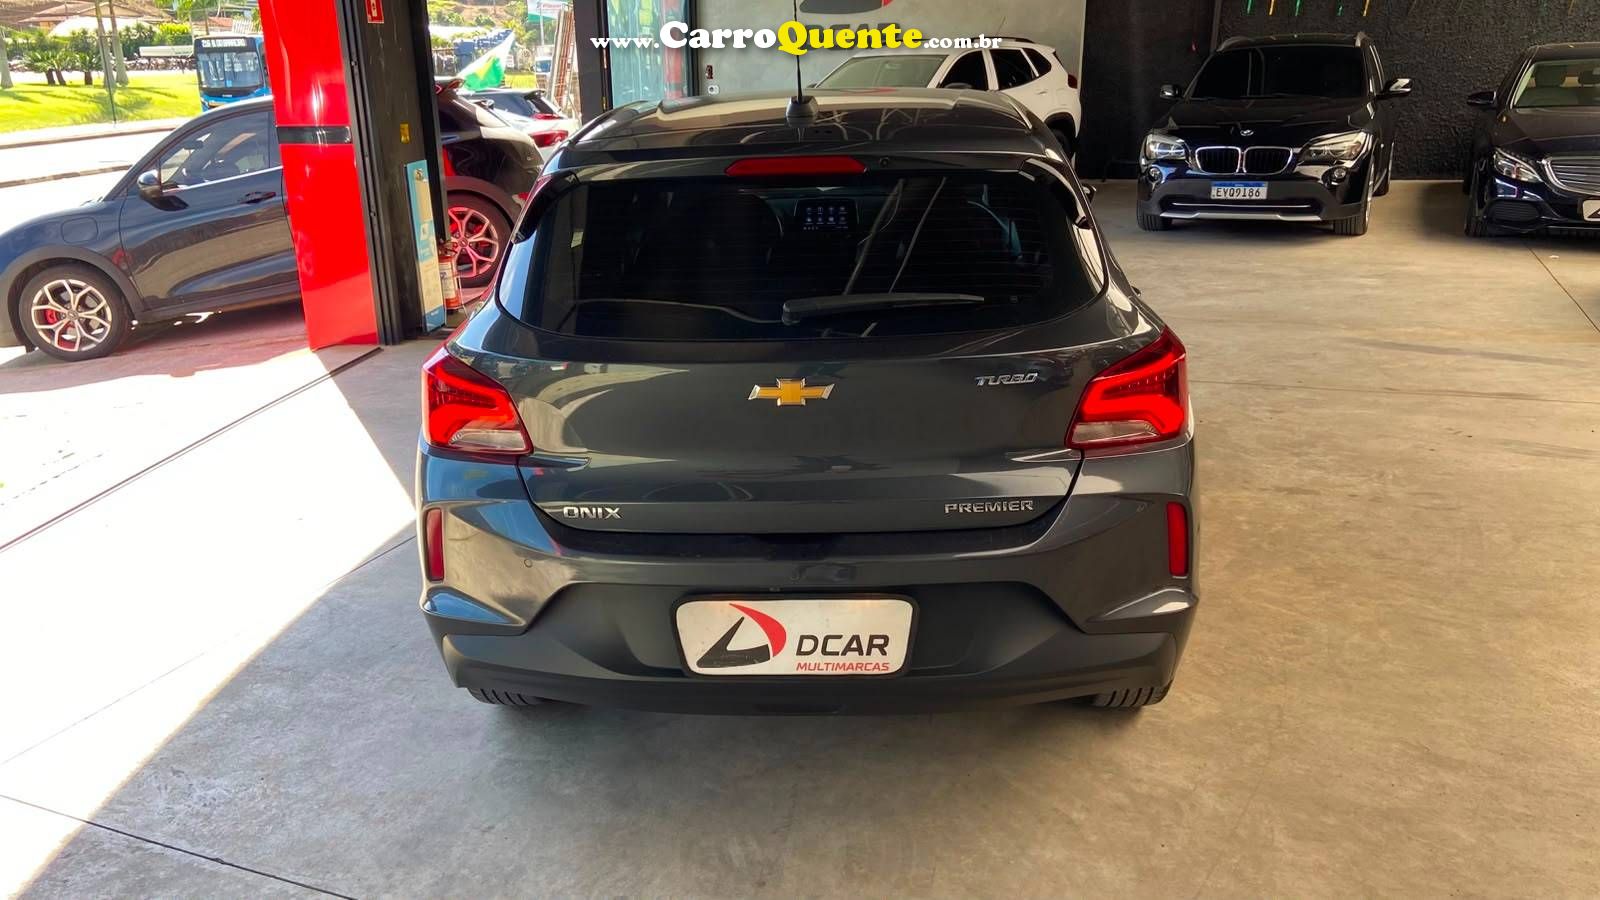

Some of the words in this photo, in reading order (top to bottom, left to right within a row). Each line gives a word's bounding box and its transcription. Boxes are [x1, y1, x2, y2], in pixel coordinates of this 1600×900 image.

[975, 372, 1038, 386] TURBO
[563, 506, 621, 519] ONIX
[944, 500, 1034, 513] PREMIER
[795, 634, 890, 656] DCAR
[796, 662, 890, 671] MULTIMARCAS
